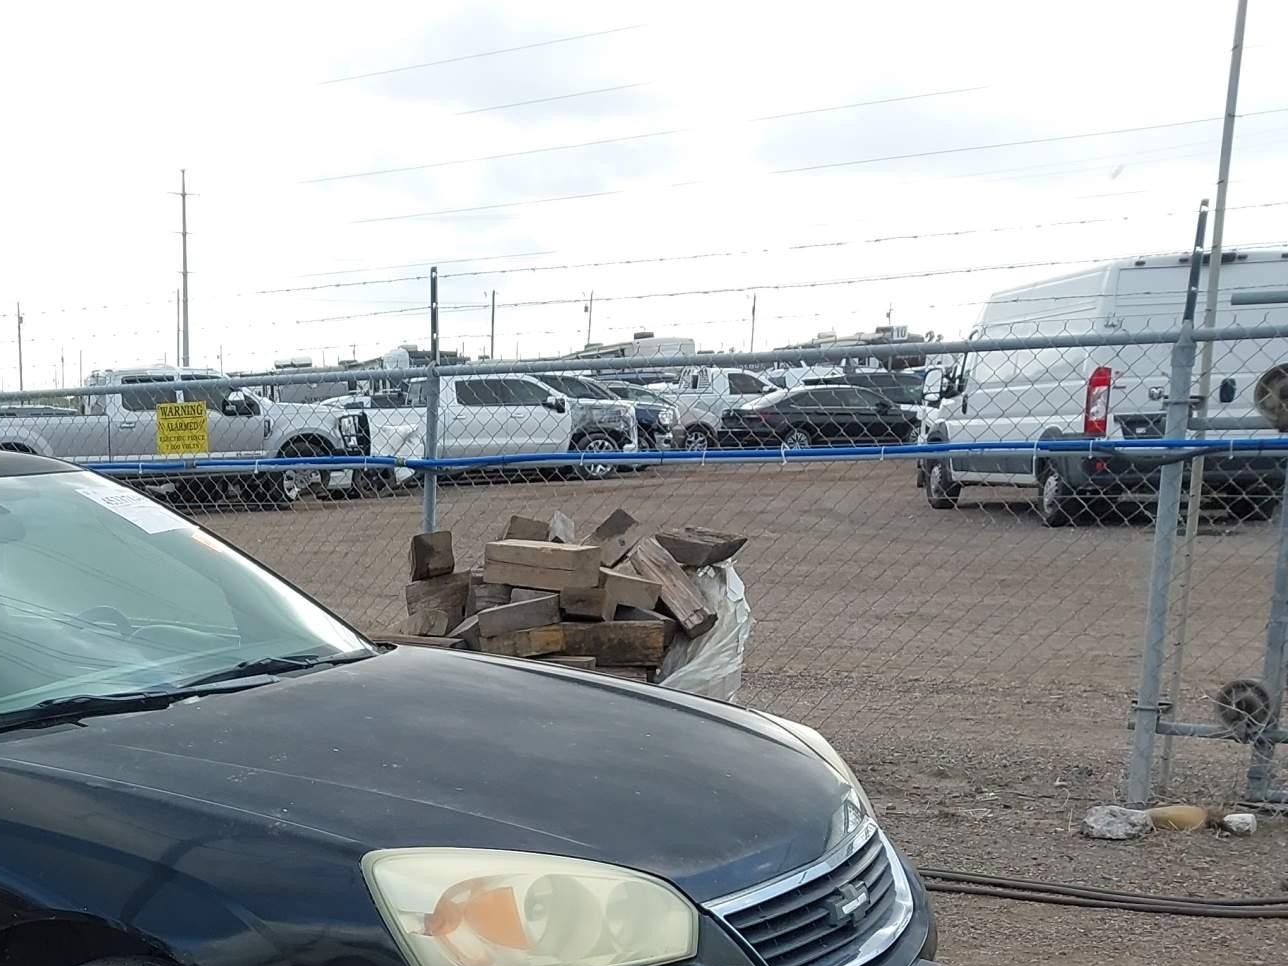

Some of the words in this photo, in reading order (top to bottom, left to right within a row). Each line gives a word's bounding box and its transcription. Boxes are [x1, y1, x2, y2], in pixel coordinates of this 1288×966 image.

[896, 326, 906, 338] 10
[160, 405, 203, 417] WARNING
[167, 421, 199, 431] ALARMED
